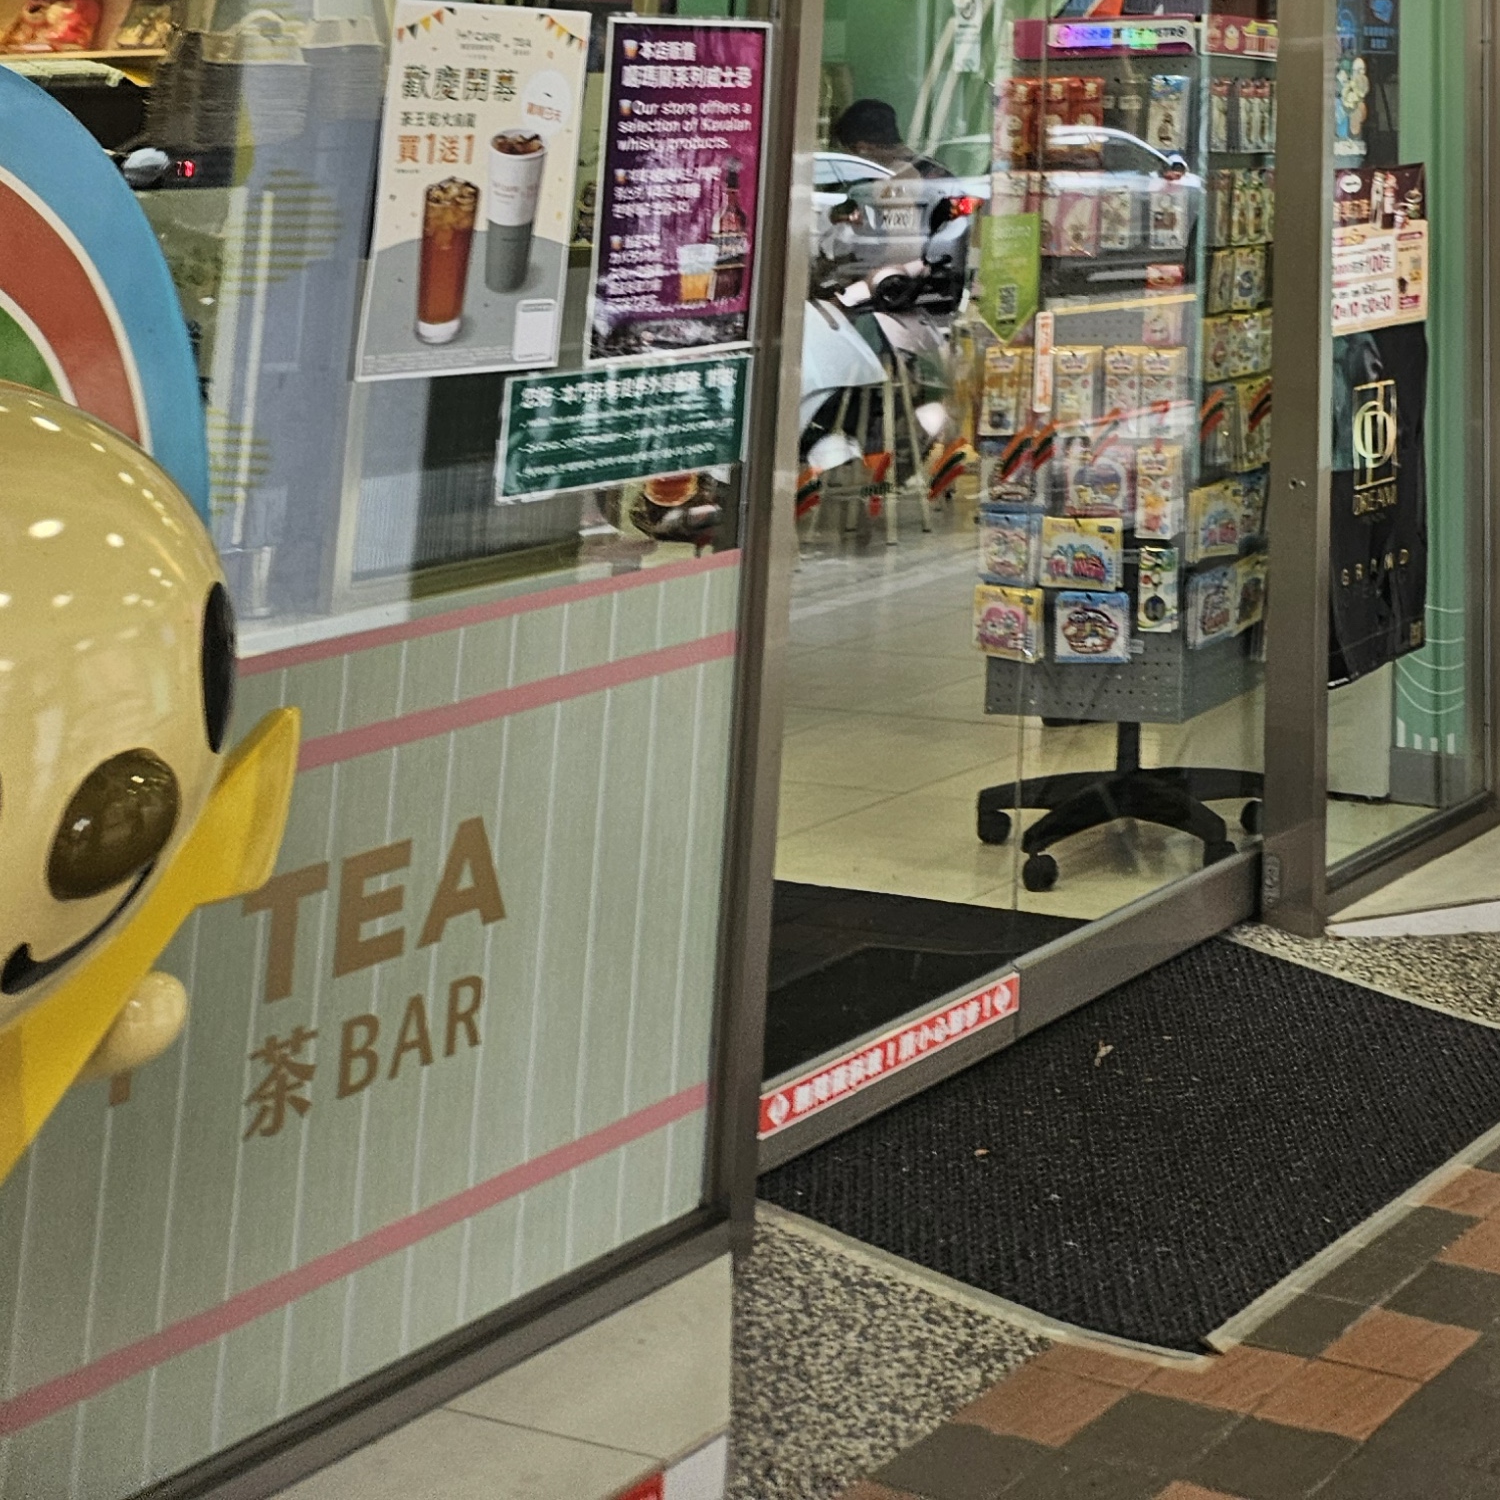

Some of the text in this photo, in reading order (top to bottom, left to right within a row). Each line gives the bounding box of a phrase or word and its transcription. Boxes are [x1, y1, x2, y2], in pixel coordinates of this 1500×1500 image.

[402, 64, 518, 102] 歡慶開幕
[617, 118, 681, 133] selection
[682, 116, 699, 131] of
[631, 100, 659, 115] Our
[661, 101, 698, 115] store
[742, 102, 752, 114] a
[396, 132, 476, 166] 買1送1
[241, 815, 507, 1004] TEA
[243, 974, 484, 1142] 茶 BAR
